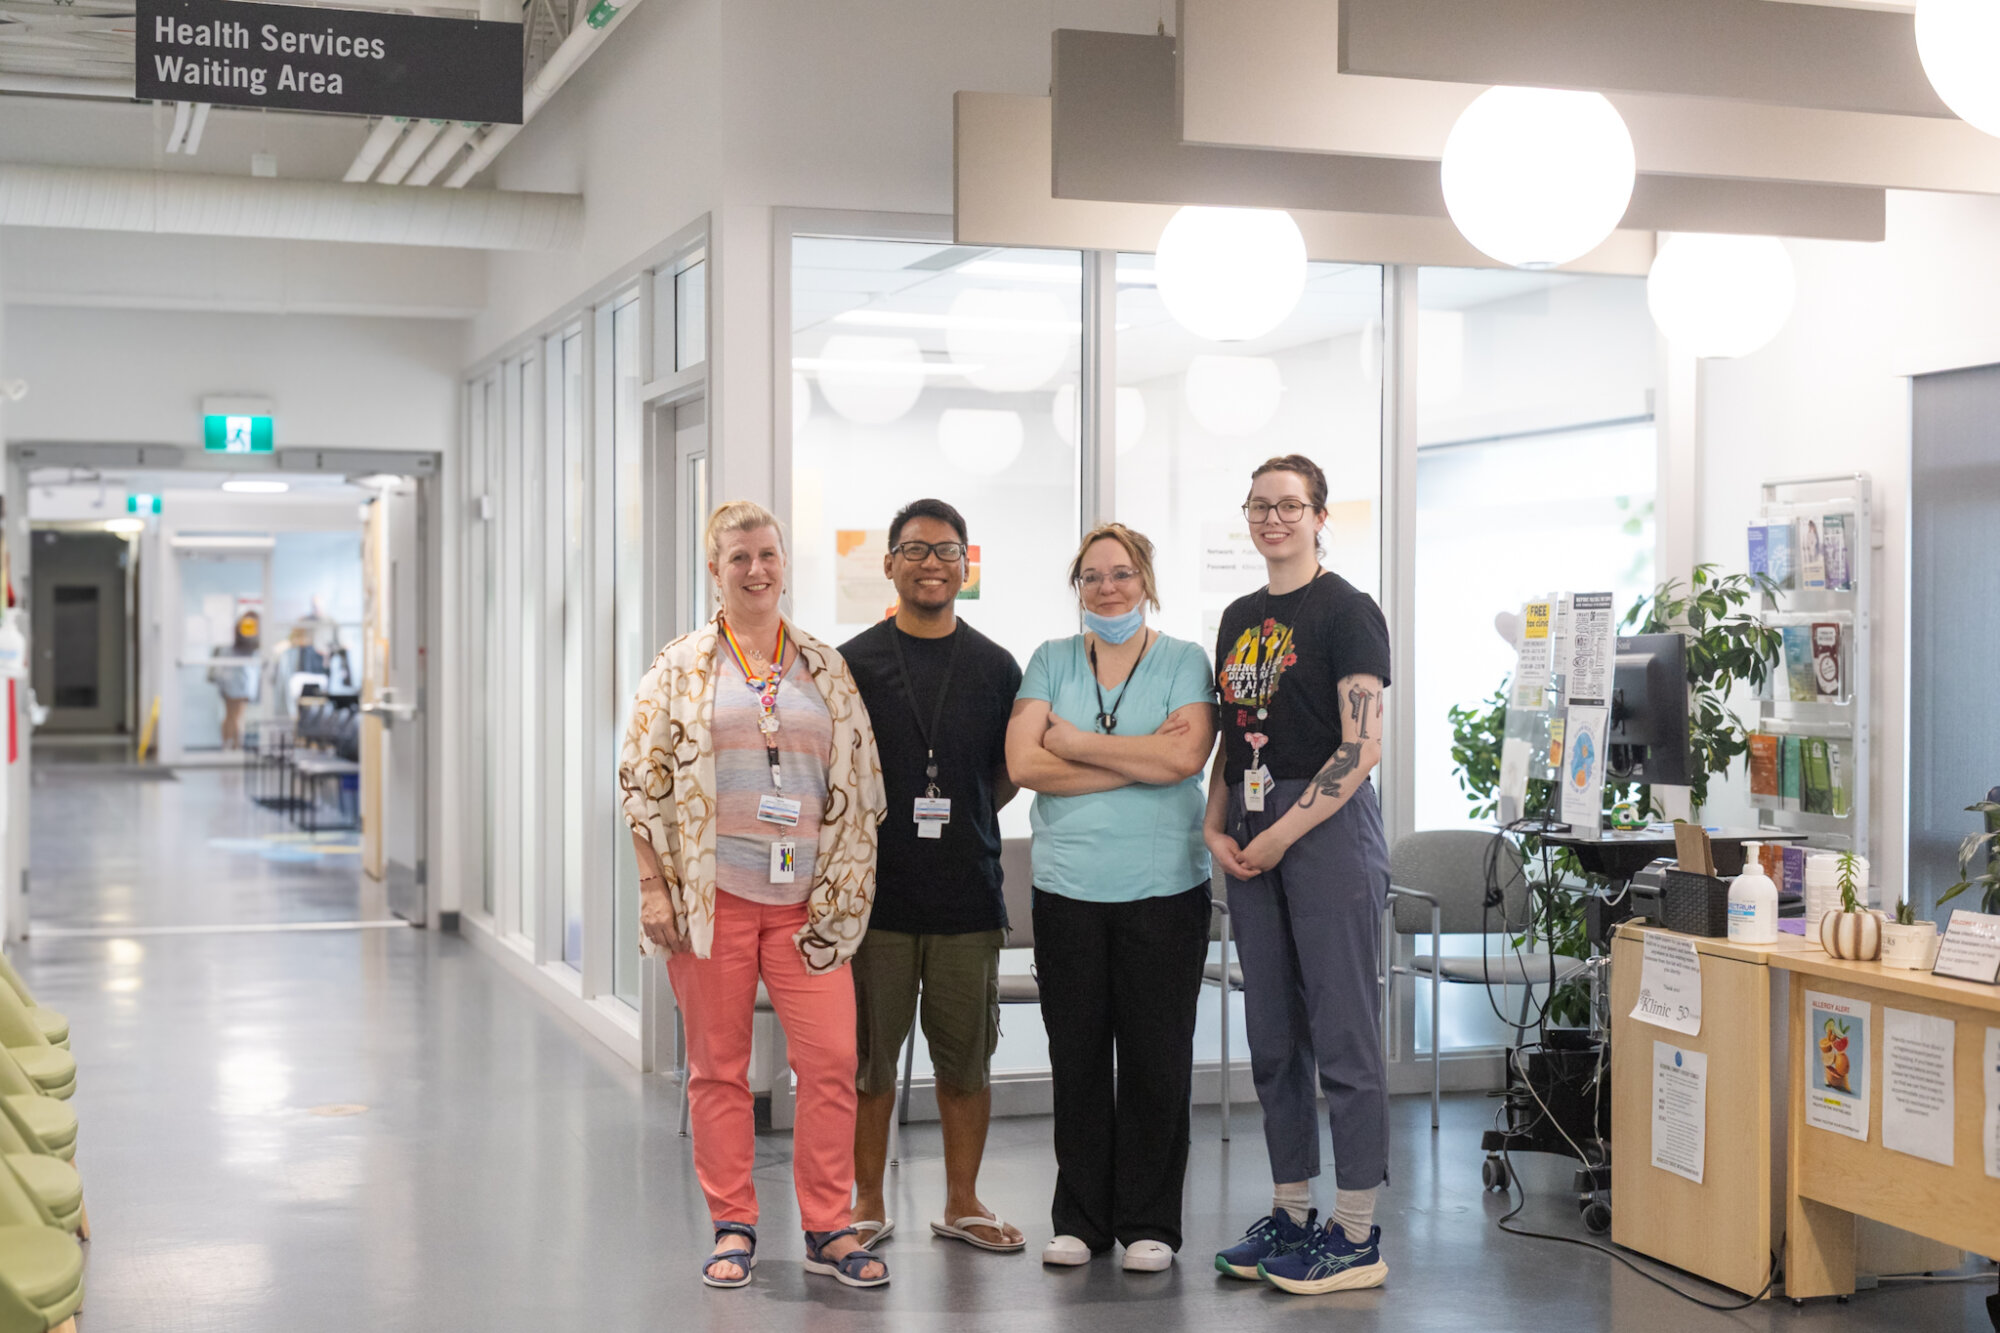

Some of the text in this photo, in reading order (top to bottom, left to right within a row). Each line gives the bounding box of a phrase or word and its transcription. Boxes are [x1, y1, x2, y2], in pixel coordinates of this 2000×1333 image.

[154, 15, 386, 60] Health Services
[154, 55, 344, 96] Waiting Area
[1530, 604, 1548, 617] FREE
[1536, 617, 1549, 628] clinic
[1225, 663, 1257, 672] BEING
[1231, 681, 1242, 690] IS
[1234, 690, 1248, 699] OF
[1641, 997, 1671, 1018] Klinic
[1812, 1001, 1850, 1013] ALLERGY ALERT
